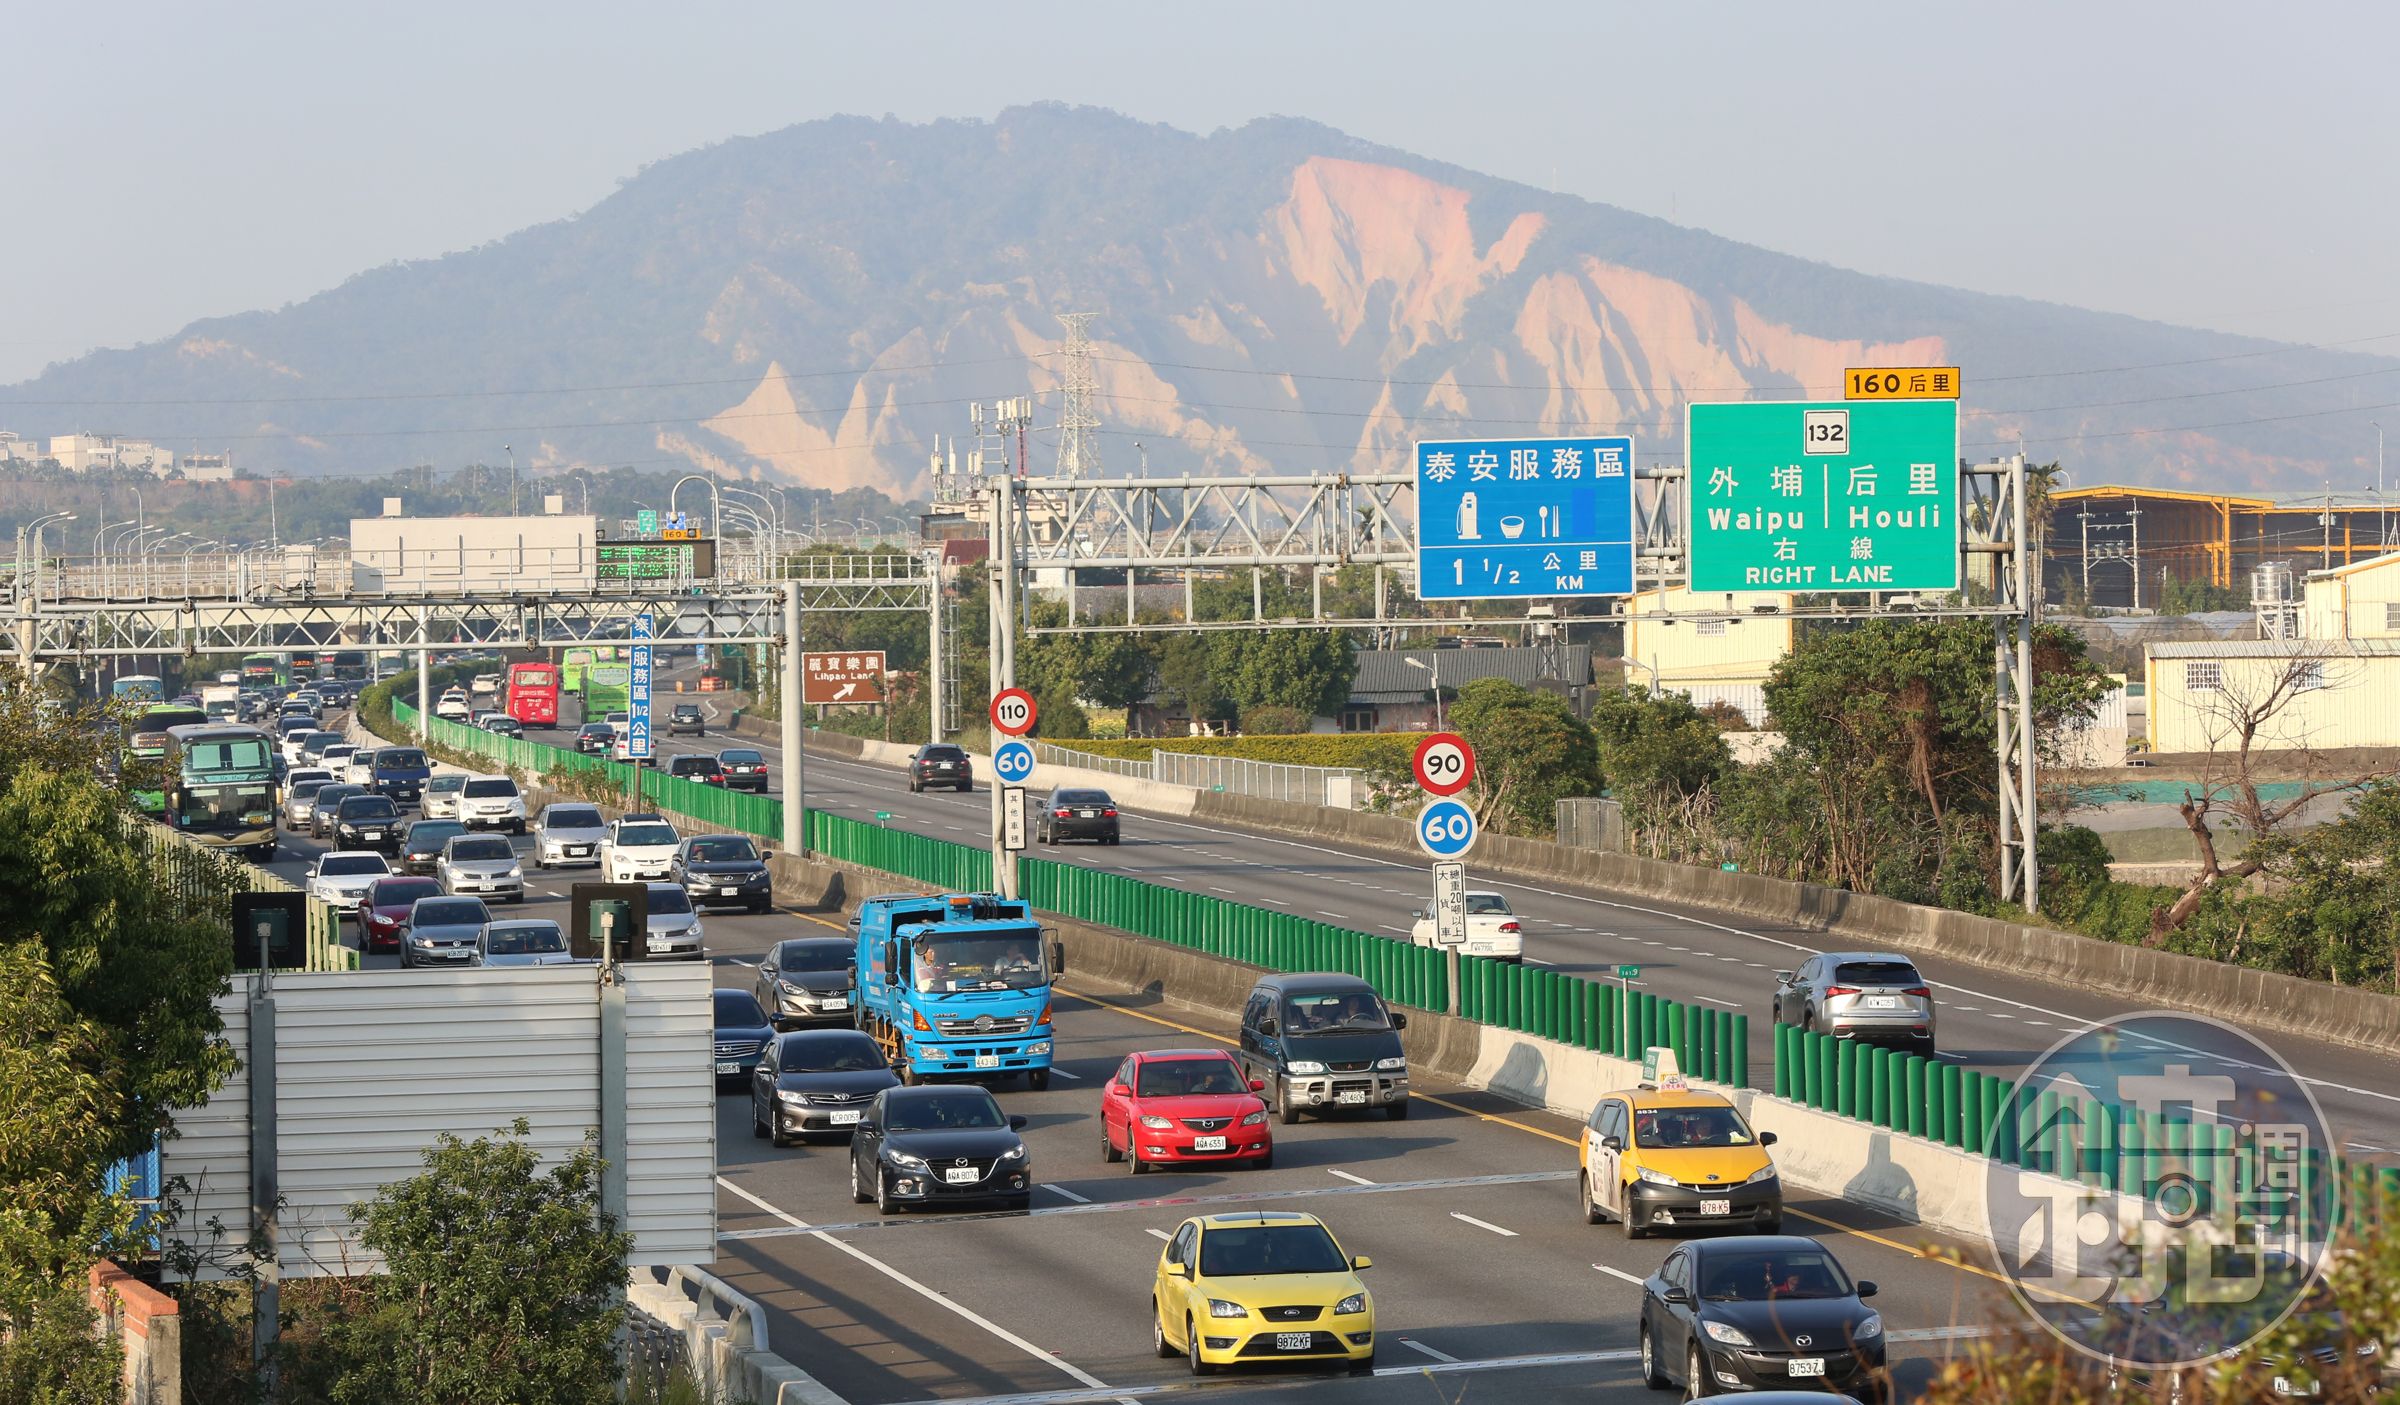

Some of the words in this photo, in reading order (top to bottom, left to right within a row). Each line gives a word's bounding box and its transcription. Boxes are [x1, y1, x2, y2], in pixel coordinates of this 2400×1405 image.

[1853, 374, 1901, 394] 160
[1908, 373, 1951, 393] 后里
[1808, 424, 1844, 442] 132
[1425, 447, 1625, 483] 泰安服務區
[1707, 464, 1803, 497] 外埔
[1846, 463, 1939, 496] 后里
[1707, 507, 1804, 535] Waipu
[1850, 504, 1940, 529] Houli
[1773, 536, 1873, 561] 右線
[1453, 558, 1463, 586] 1
[1542, 550, 1598, 571] 公里
[1556, 575, 1584, 590] KM
[1746, 565, 1816, 584] RIGHT
[1830, 565, 1893, 583] LANE
[808, 656, 879, 671] 麗寶樂園
[814, 672, 847, 682] Lihpao
[850, 671, 875, 680] Land
[1000, 704, 1026, 720] 110
[631, 721, 647, 754] 公里
[997, 752, 1030, 773] 60
[1427, 754, 1461, 776] 90
[1425, 814, 1468, 842] 60
[1438, 870, 1452, 938] 大貨車
